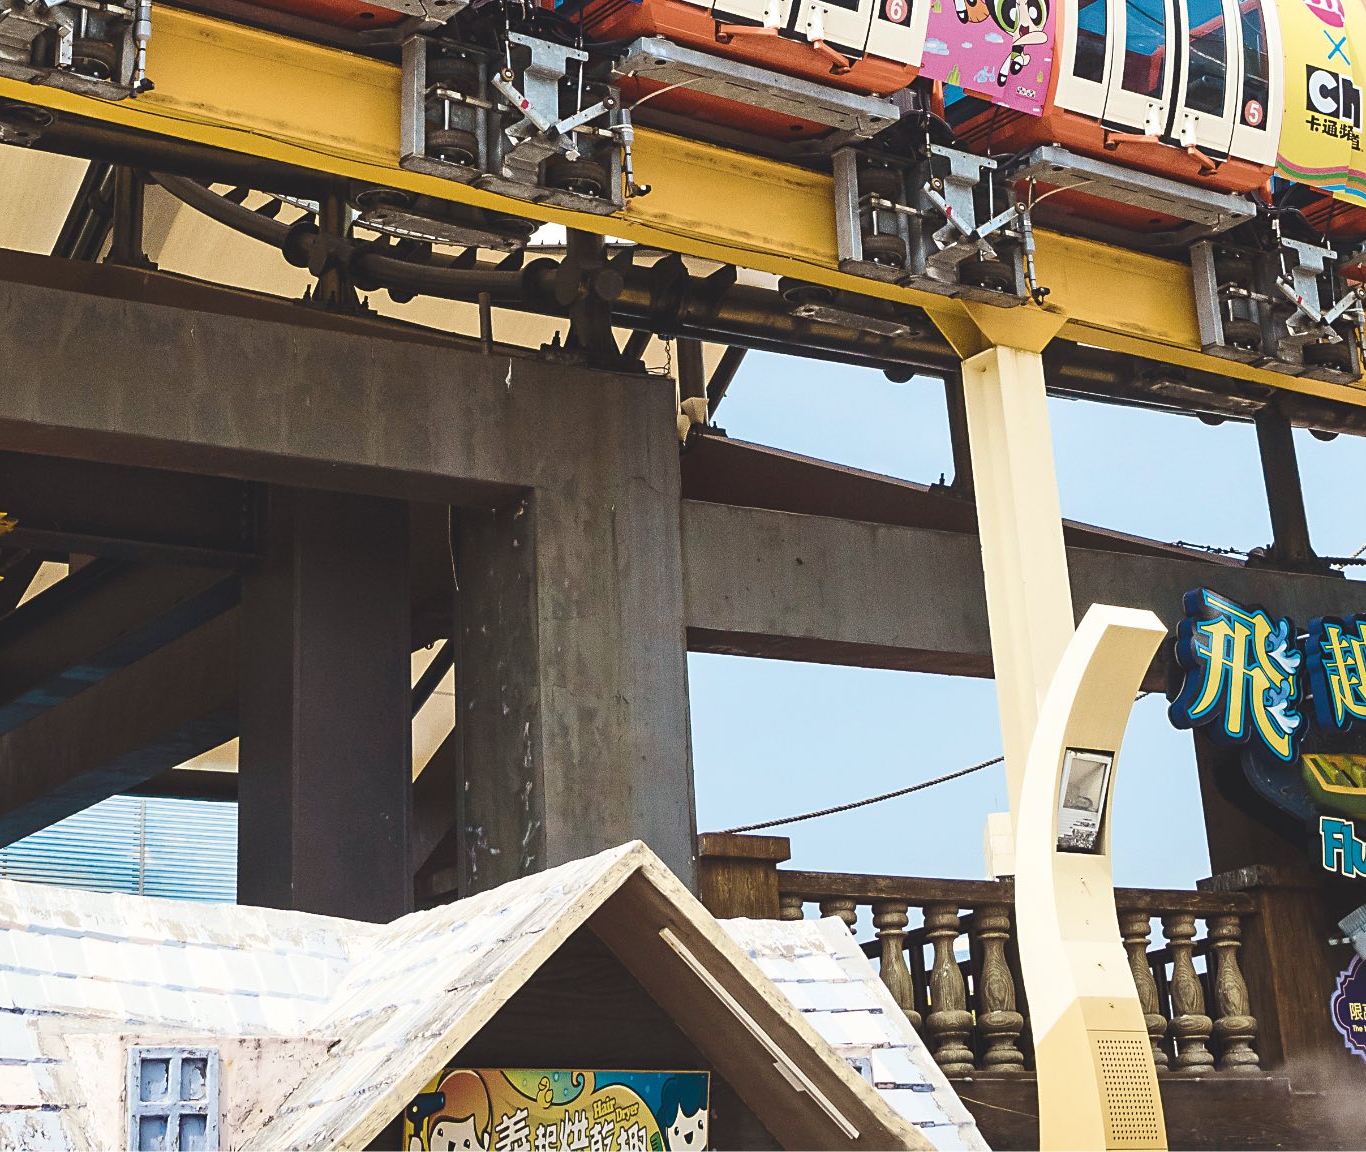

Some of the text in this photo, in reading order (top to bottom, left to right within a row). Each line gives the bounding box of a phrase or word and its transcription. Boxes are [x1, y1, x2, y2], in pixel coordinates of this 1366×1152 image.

[1249, 103, 1259, 123] 5
[1352, 1024, 1363, 1033] The
[592, 1096, 640, 1123] Hair Dryer
